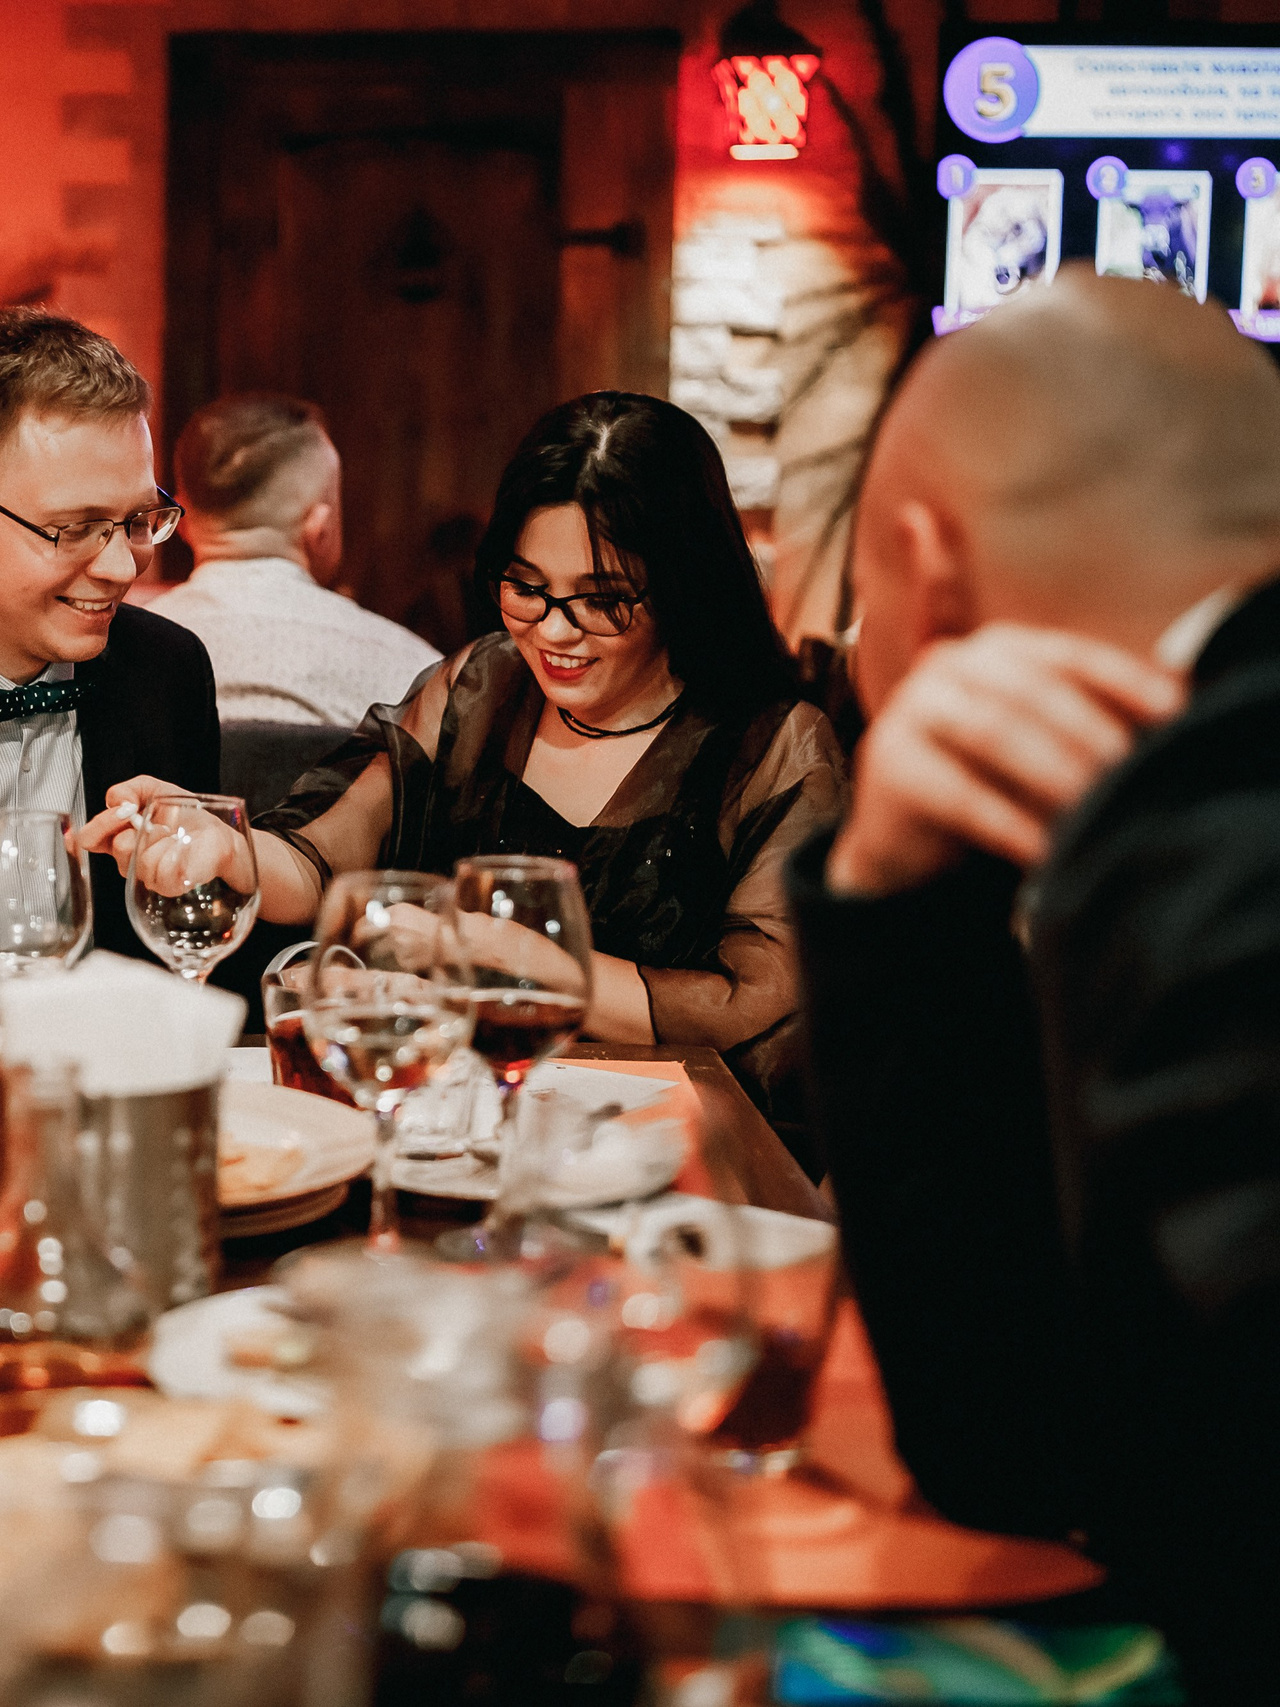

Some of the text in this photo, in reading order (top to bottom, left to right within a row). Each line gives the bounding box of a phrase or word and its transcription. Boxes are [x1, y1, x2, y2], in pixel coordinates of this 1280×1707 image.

[974, 61, 1017, 121] 5
[950, 164, 964, 189] 1
[1098, 164, 1120, 190] 2
